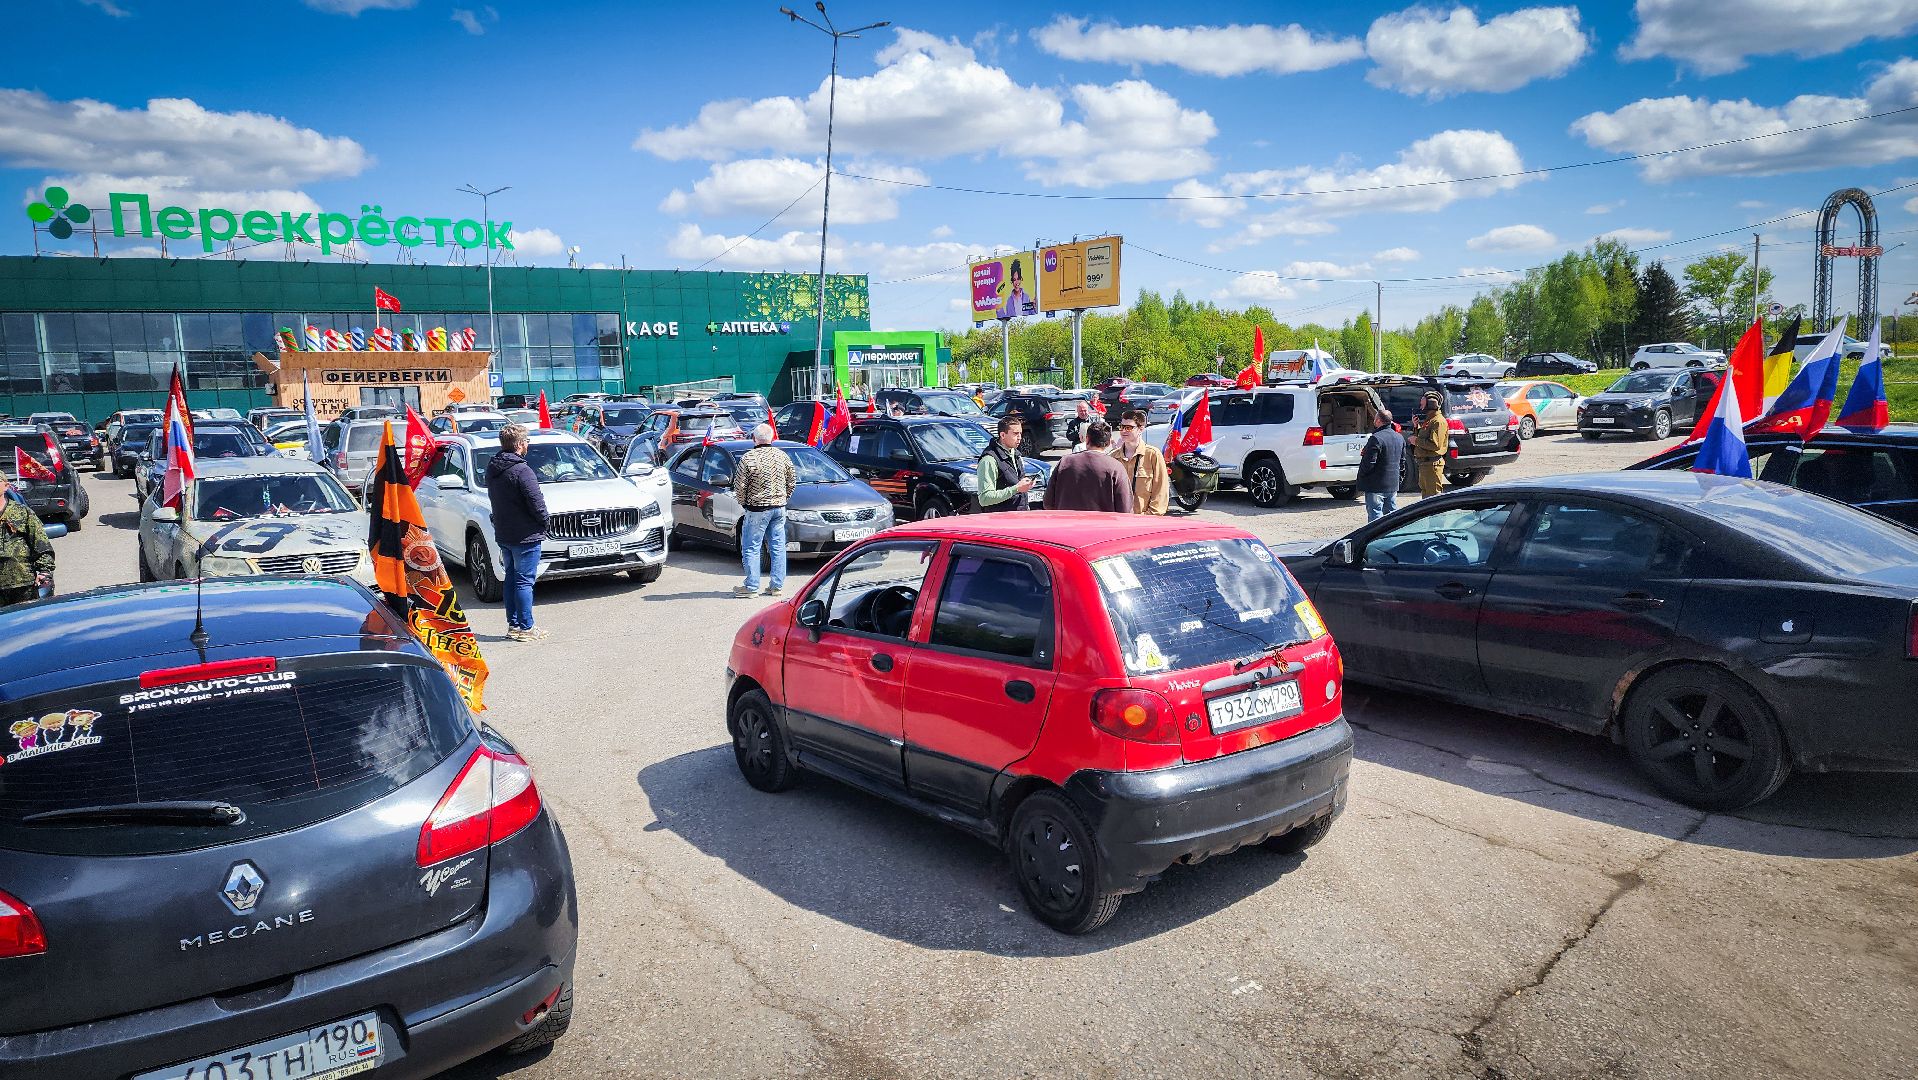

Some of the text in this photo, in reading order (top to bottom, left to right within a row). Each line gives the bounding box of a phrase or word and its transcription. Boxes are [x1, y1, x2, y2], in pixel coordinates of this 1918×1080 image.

[109, 192, 515, 255] Перекрёсток
[626, 321, 678, 336] КАФЕ
[721, 321, 778, 333] АПТЕКА
[119, 671, 297, 705] BRON-AUTO-CLUB
[174, 692, 212, 706] крутые
[179, 909, 315, 951] MEGANE
[315, 1019, 368, 1055] 190
[329, 1048, 356, 1065] RUS
